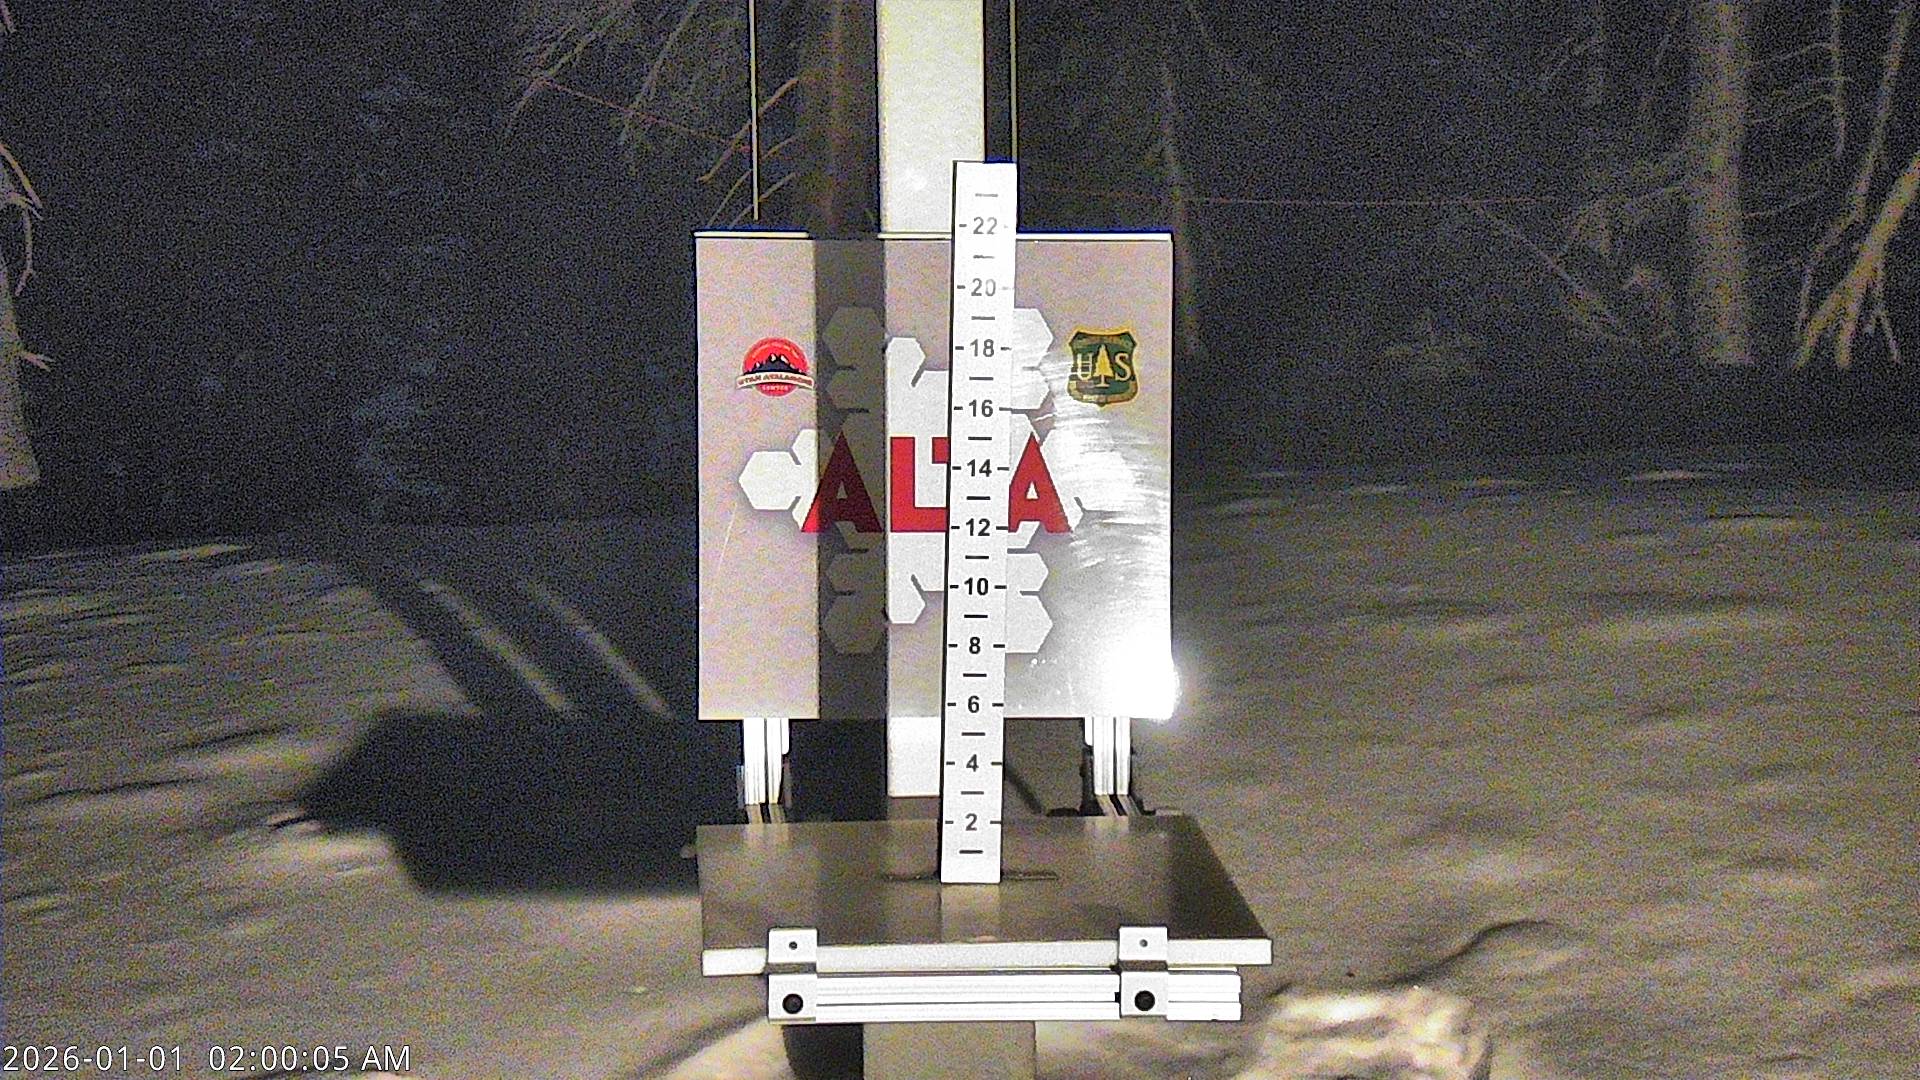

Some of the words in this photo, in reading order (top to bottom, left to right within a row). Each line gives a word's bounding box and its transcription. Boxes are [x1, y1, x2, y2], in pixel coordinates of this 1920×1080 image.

[972, 217, 998, 235] 22
[971, 278, 997, 297] 20
[969, 339, 995, 358] 18
[968, 399, 994, 418] 16
[966, 459, 993, 478] 14
[801, 432, 1072, 533] ALA
[965, 518, 991, 537] 12
[964, 577, 989, 596] 10
[968, 637, 982, 655] 8
[967, 695, 980, 714] 6
[965, 754, 979, 772] 4
[965, 813, 978, 831] 2
